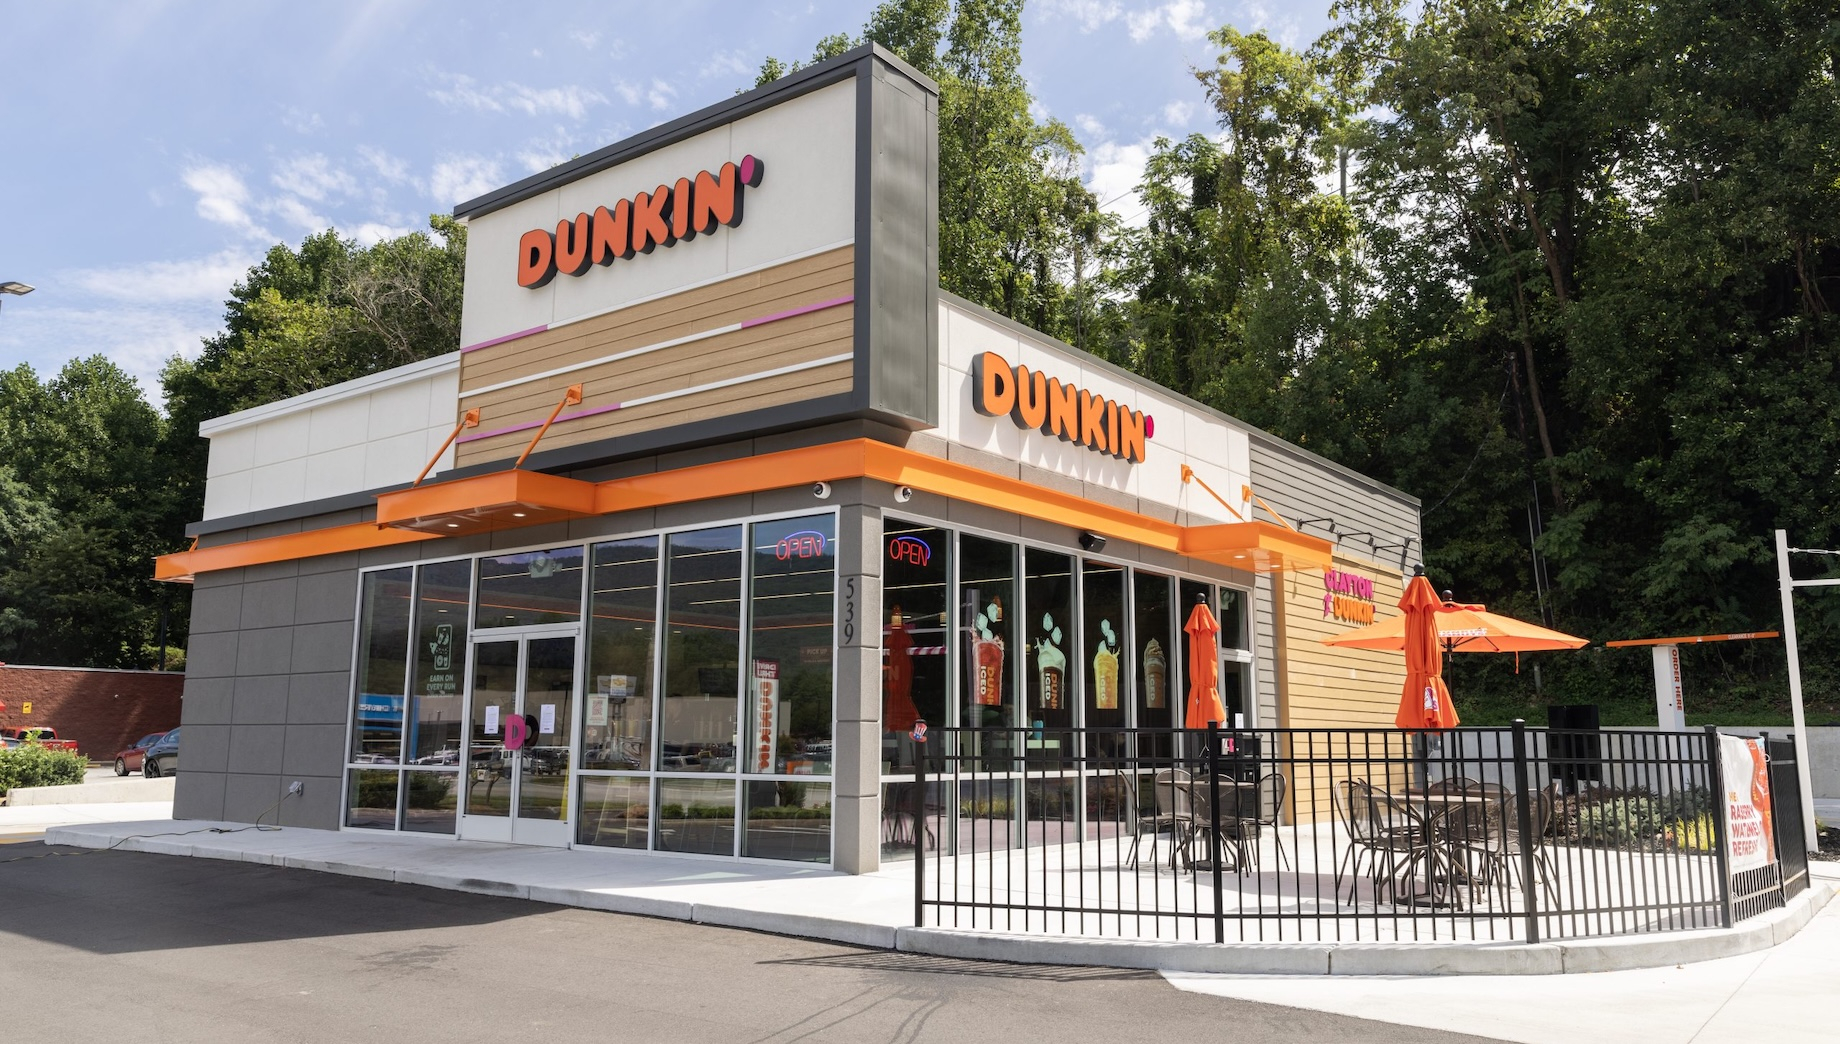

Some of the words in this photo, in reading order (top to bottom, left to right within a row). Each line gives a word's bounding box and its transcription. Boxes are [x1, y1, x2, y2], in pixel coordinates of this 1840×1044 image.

[517, 154, 764, 289] DUNKIN'
[972, 351, 1154, 464] DUNKIN'
[776, 537, 822, 560] OPEN
[890, 539, 928, 566] OPEN
[1324, 570, 1373, 602] CLAYTON
[844, 578, 854, 645] 539
[1333, 596, 1376, 626] DUNKIN'
[1672, 649, 1680, 682] ORDER
[427, 683, 443, 691] EVERY
